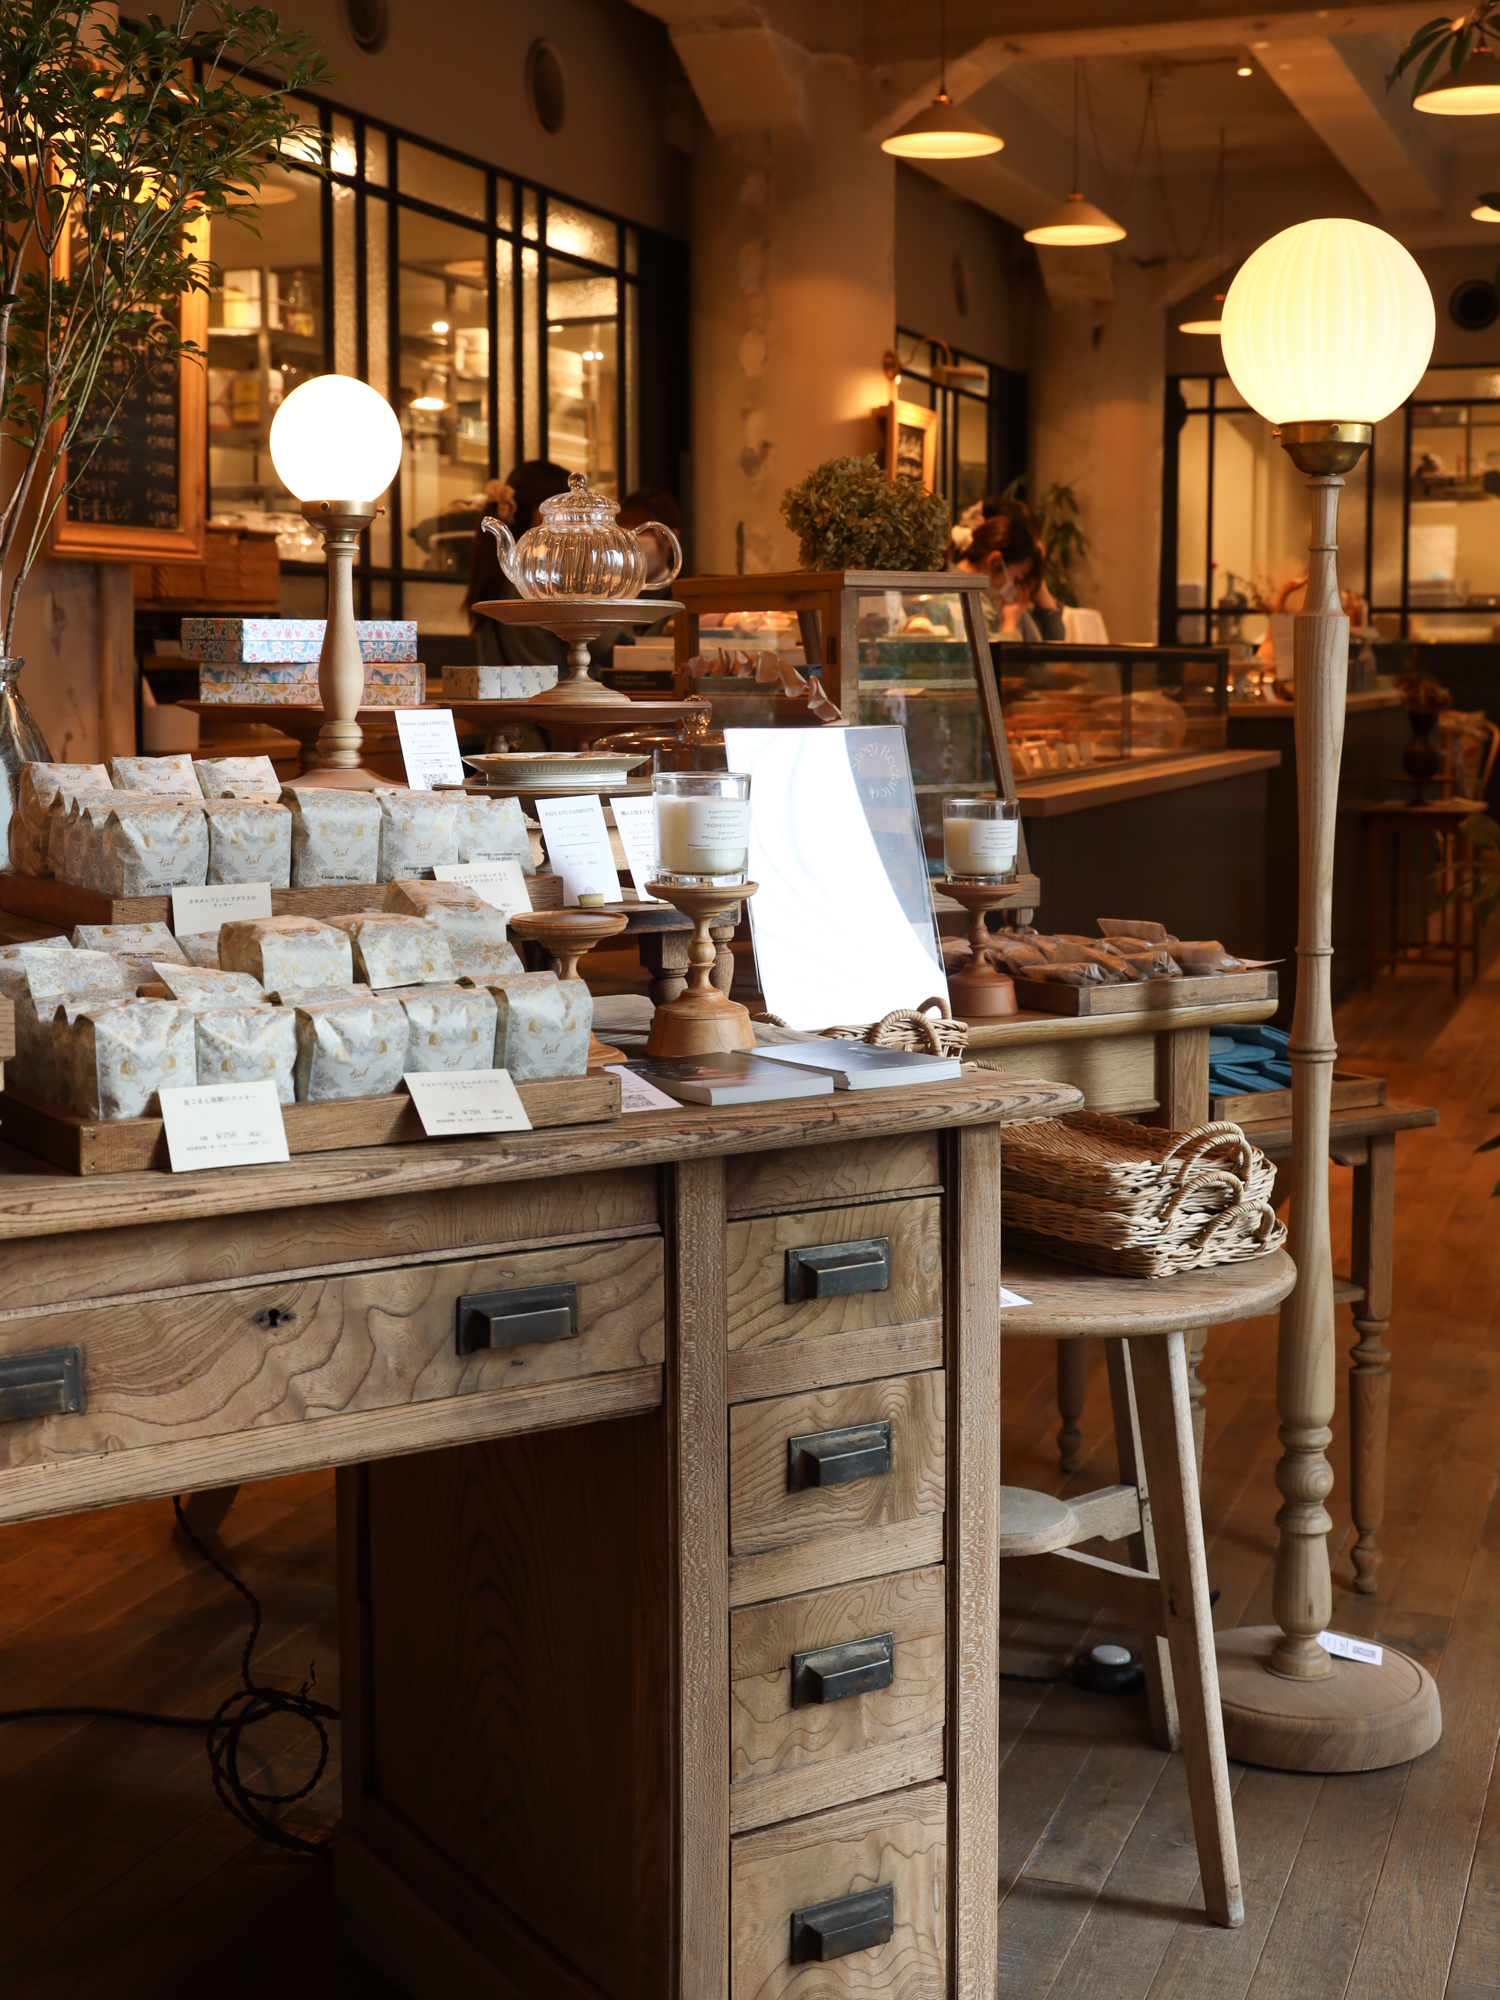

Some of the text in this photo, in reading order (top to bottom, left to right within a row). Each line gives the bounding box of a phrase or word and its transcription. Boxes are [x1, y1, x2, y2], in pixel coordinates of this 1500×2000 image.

[544, 807, 595, 817] PRIVATE COMPOTE
[332, 847, 350, 858] teal
[157, 855, 176, 868] teal
[243, 854, 262, 865] teal
[541, 1043, 561, 1055] teal
[442, 1055, 463, 1068] teal
[348, 1066, 370, 1079] teal
